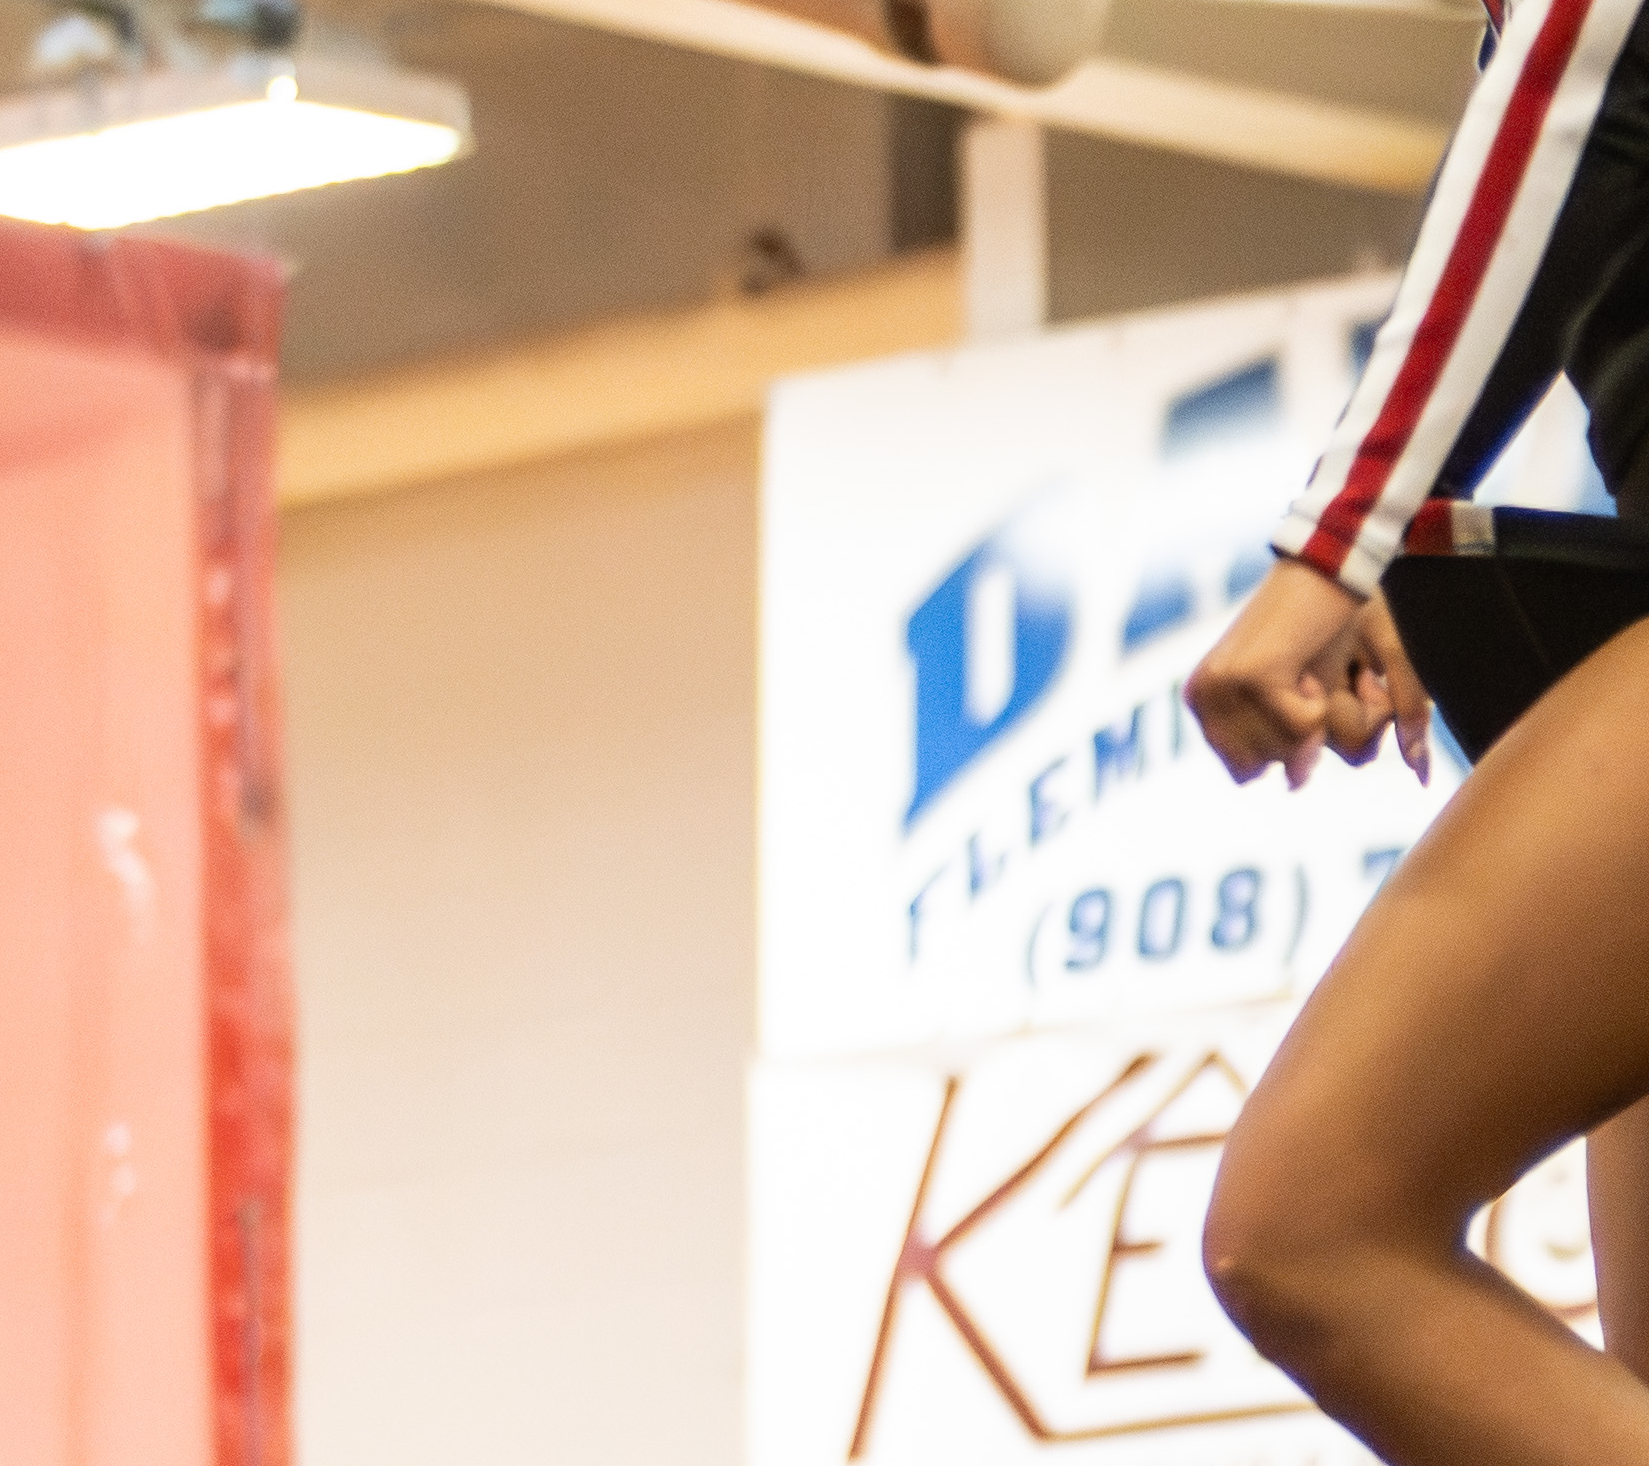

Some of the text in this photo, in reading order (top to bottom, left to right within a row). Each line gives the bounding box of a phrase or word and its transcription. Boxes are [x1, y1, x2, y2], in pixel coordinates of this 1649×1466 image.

[904, 684, 1191, 966] FLEMI
[1023, 860, 1311, 990] (908)
[846, 1049, 1223, 1466] KE
